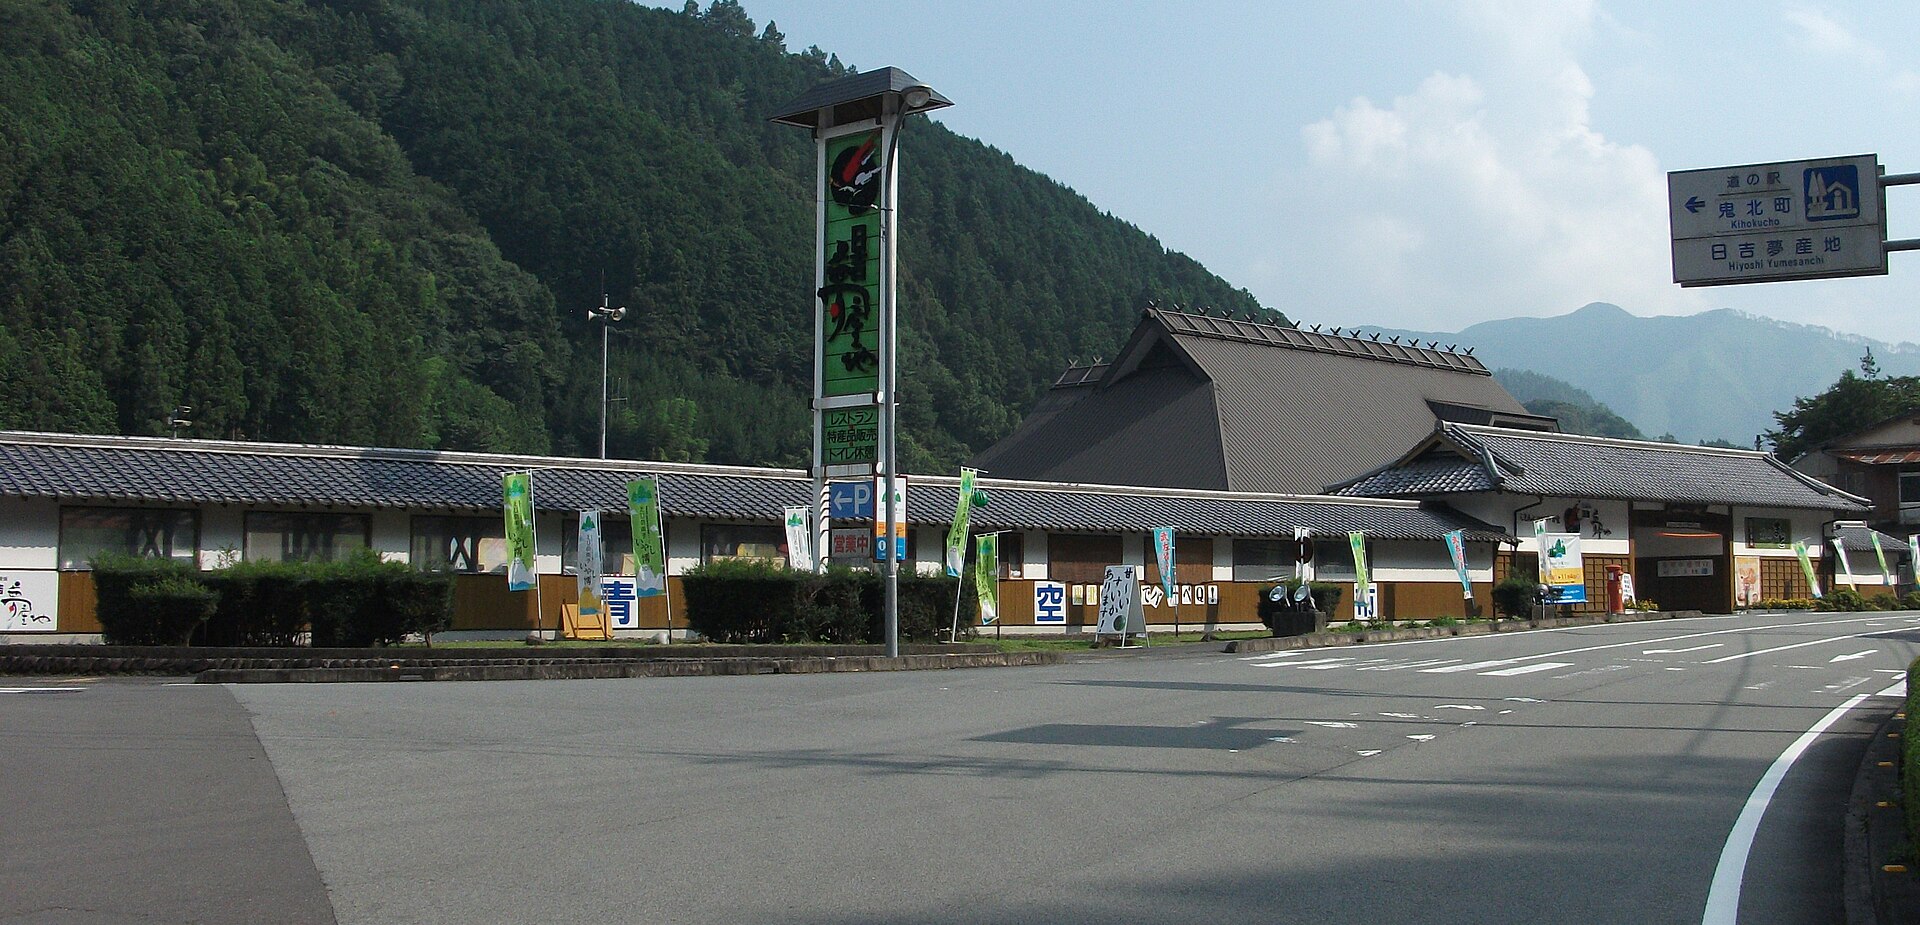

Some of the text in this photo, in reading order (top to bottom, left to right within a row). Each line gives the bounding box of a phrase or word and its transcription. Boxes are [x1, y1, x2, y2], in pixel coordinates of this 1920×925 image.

[1726, 171, 1781, 189] 道の駅
[1718, 197, 1792, 219] 鬼北町
[1730, 218, 1780, 229] Kihokucho
[1711, 236, 1841, 261] 日吉夢産地
[1728, 256, 1825, 272] Hiyoshi Yumesanchi
[830, 411, 874, 426] レストラン
[826, 428, 877, 444] 特産品販売
[828, 446, 875, 461] トイレ休憩
[854, 484, 871, 515] P
[833, 534, 869, 554] 営業中
[602, 581, 636, 625] 青
[1037, 583, 1064, 622] 空
